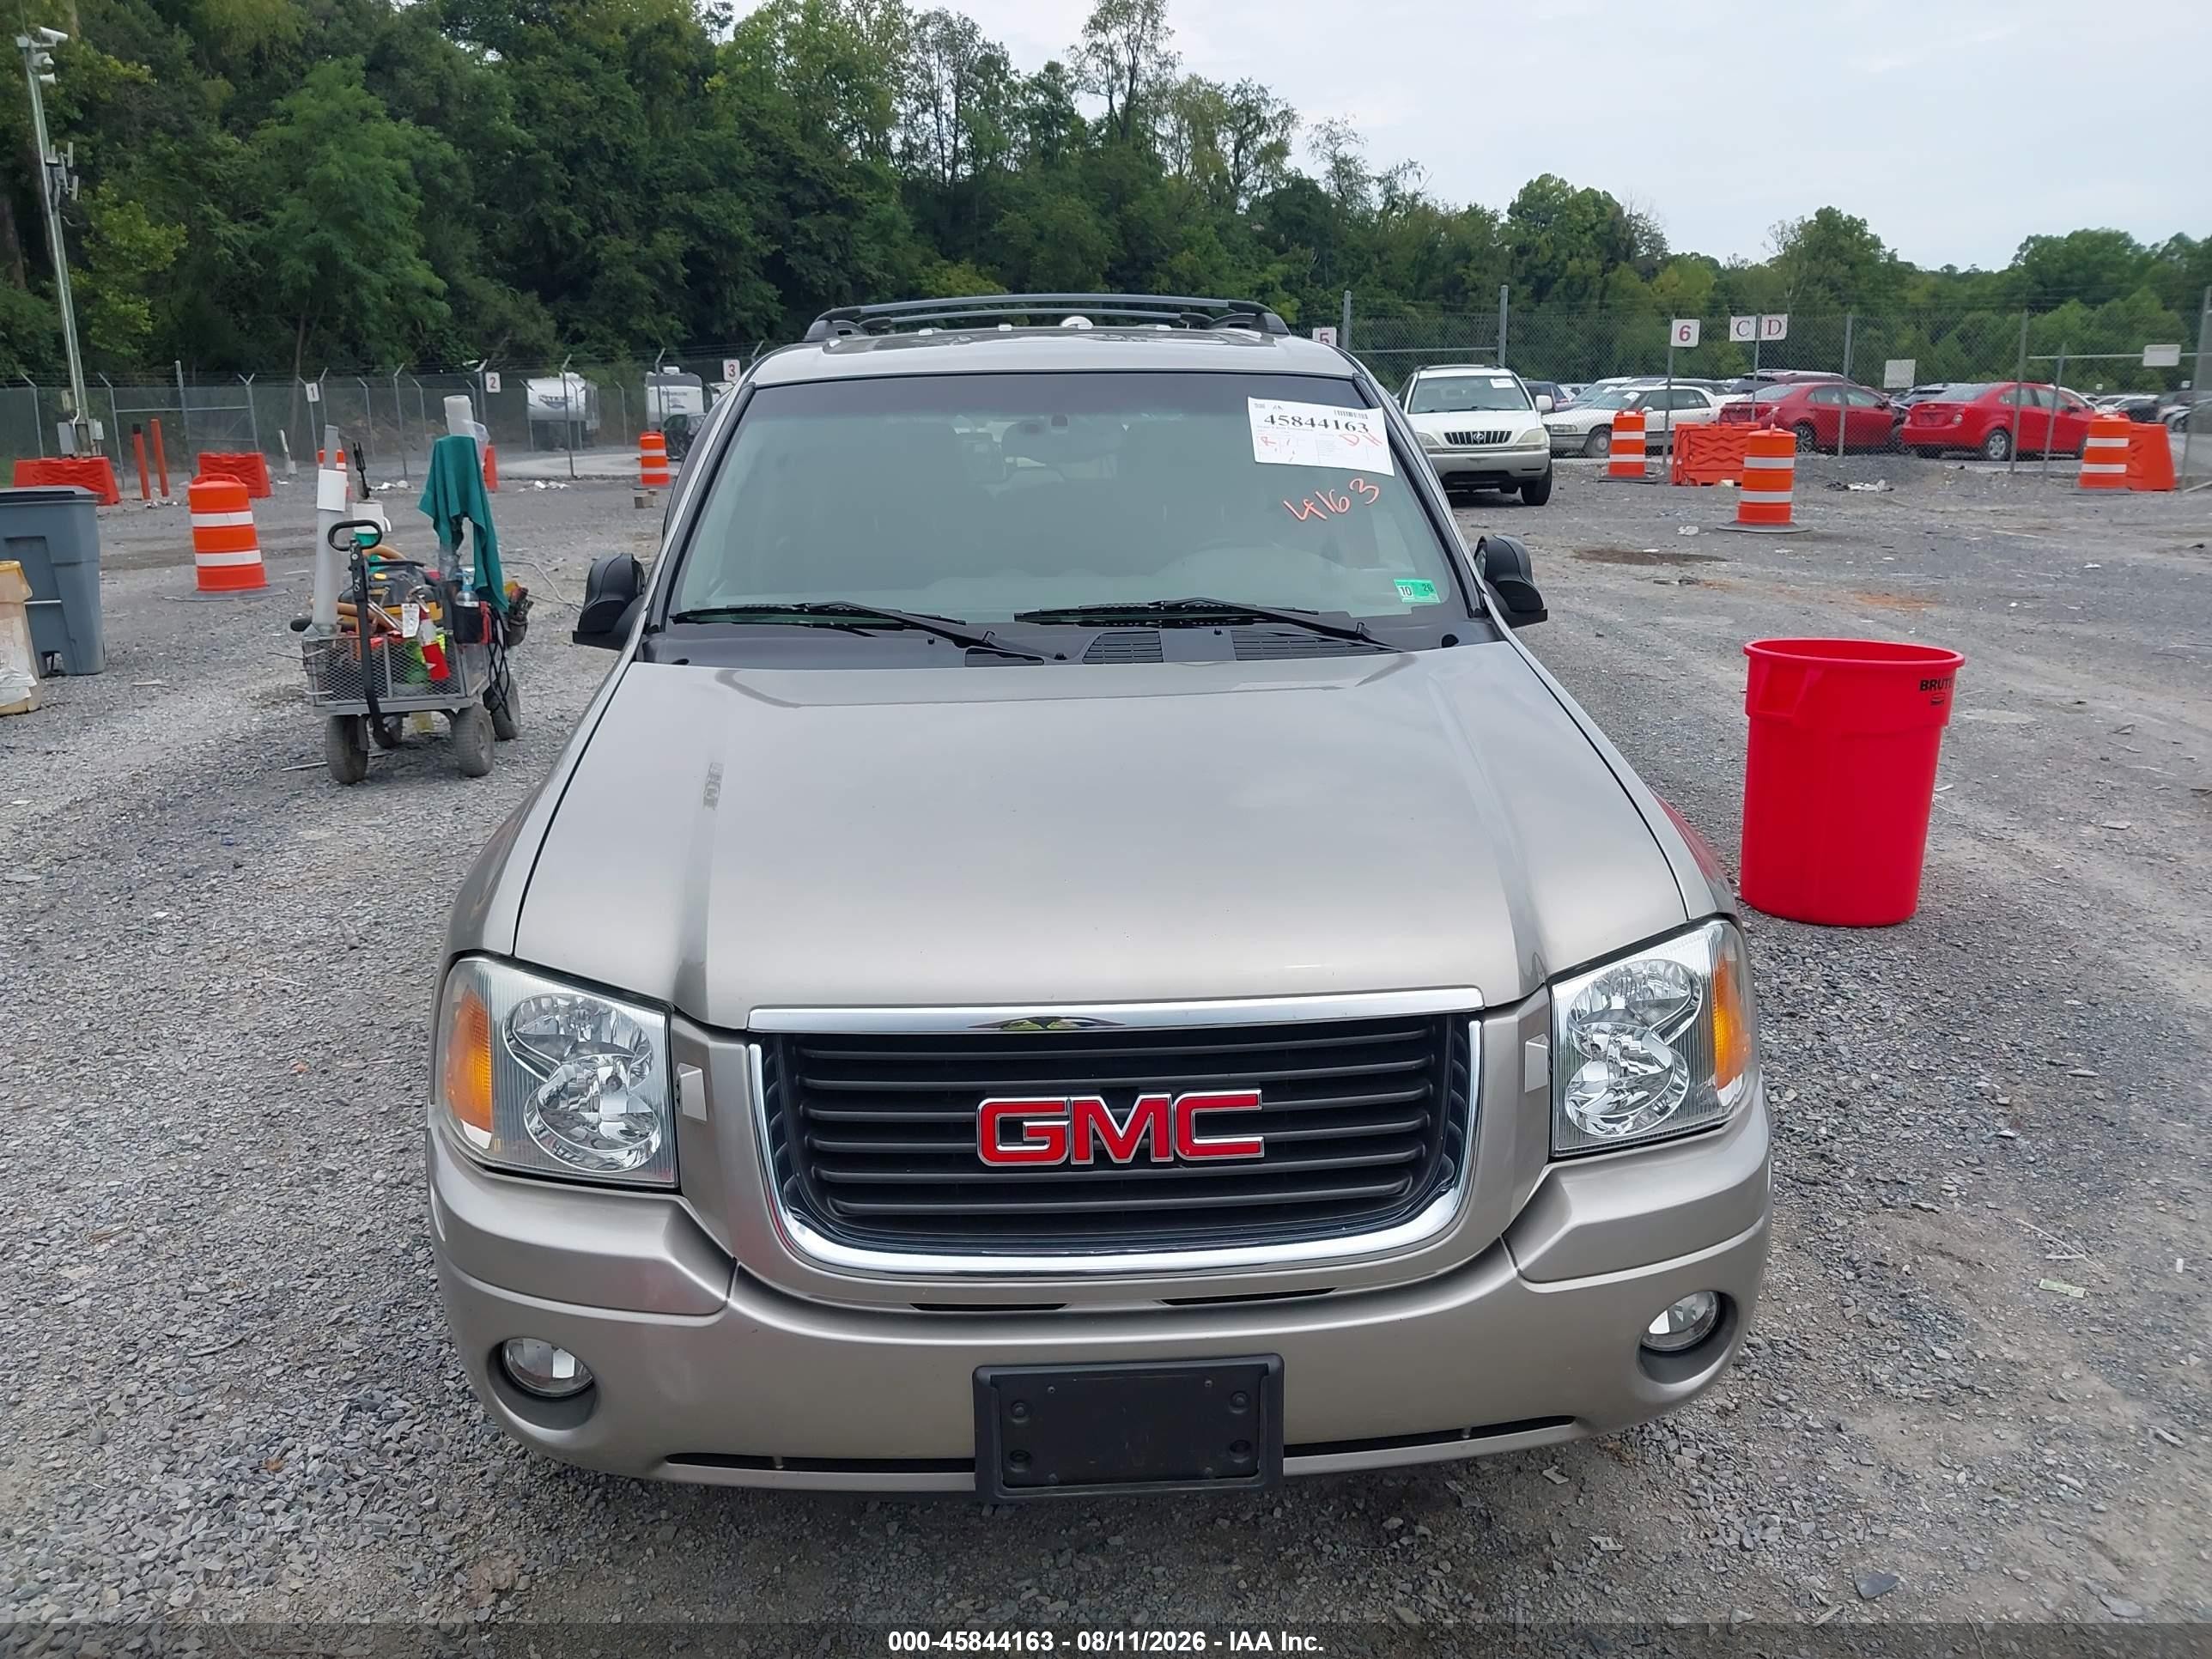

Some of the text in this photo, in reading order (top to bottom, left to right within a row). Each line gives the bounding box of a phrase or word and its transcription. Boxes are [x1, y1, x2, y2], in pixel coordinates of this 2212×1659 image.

[1679, 325, 1692, 342] 6
[1736, 319, 1750, 337] C
[1767, 319, 1782, 336] D
[1319, 332, 1330, 343] 5
[727, 363, 736, 378] 3
[489, 376, 497, 389] 2
[1264, 413, 1370, 434] 45844163
[1283, 477, 1380, 522] 4163
[1400, 586, 1413, 596] 10
[976, 1089, 1265, 1167] GMC
